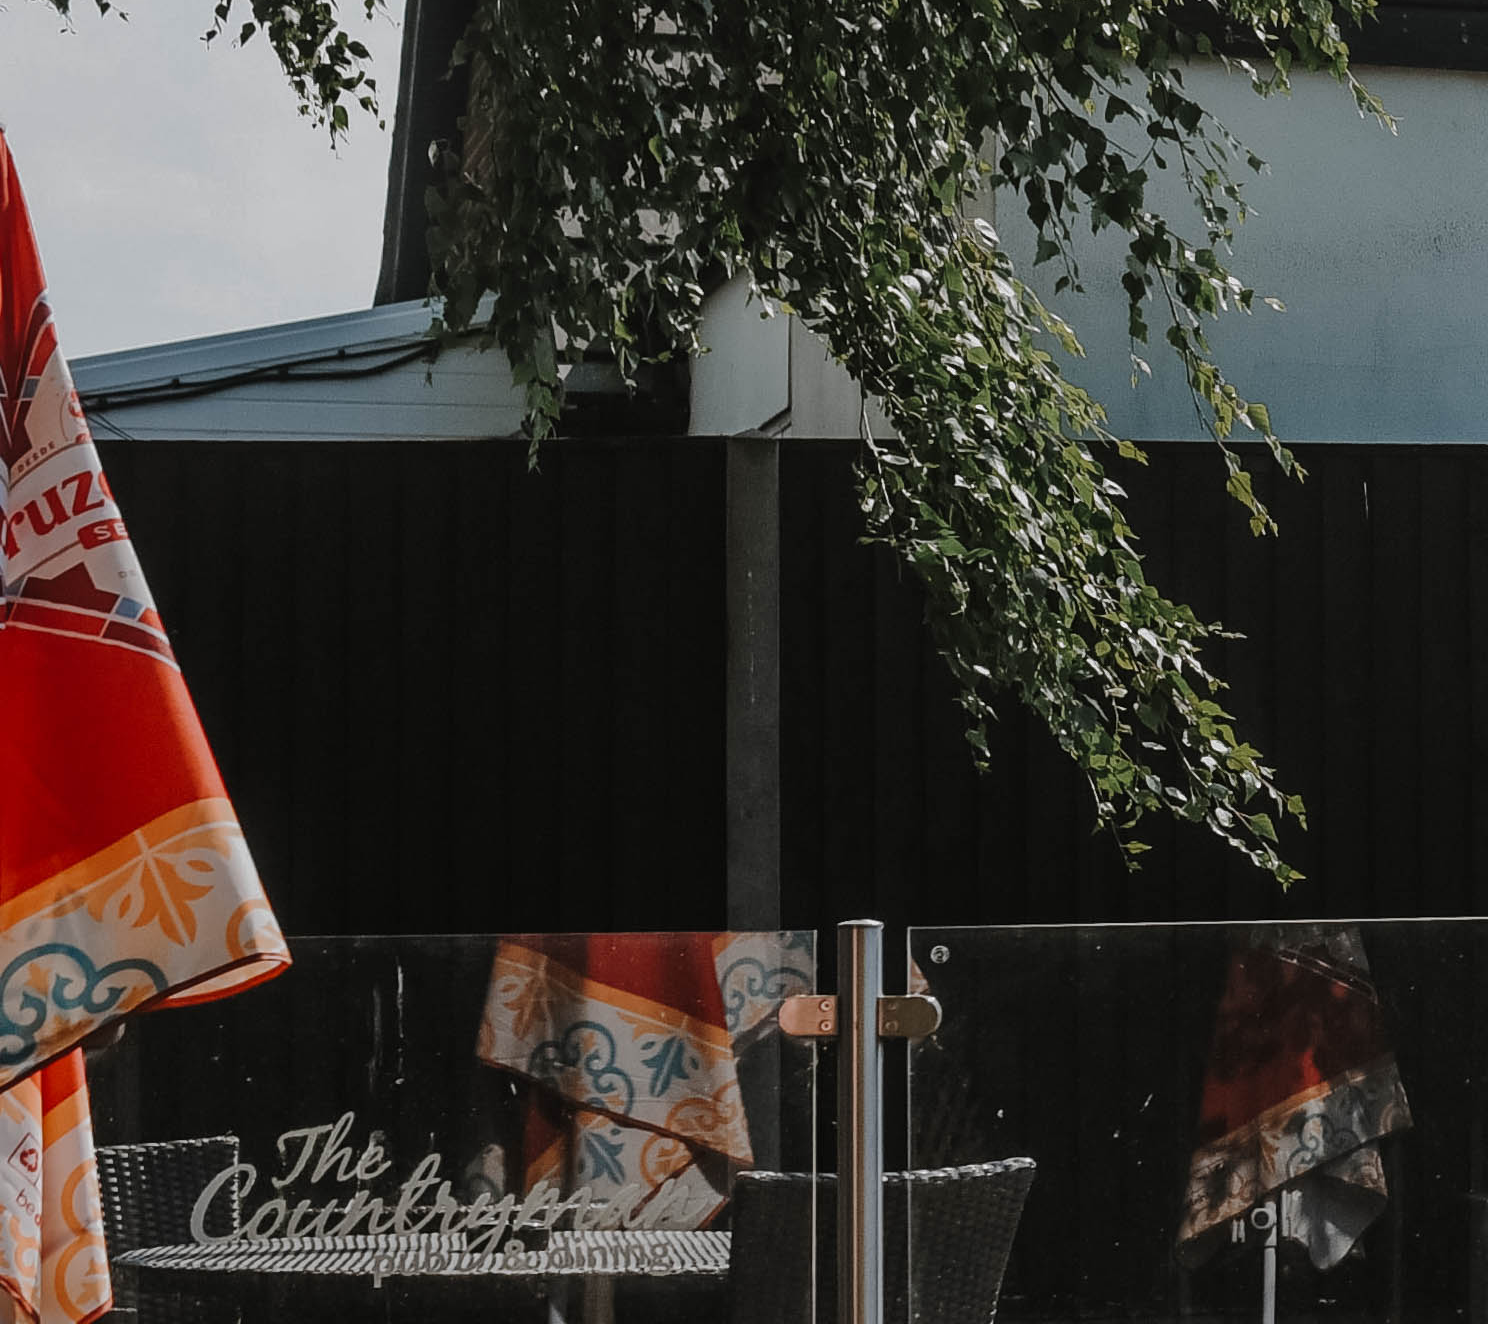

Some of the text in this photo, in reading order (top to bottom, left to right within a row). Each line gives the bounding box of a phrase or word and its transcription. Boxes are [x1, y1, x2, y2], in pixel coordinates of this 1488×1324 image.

[17, 441, 57, 474] DESDE
[272, 1110, 394, 1187] The
[189, 1153, 729, 1272] Countryman
[503, 1239, 532, 1272] &
[553, 1237, 672, 1274] dining
